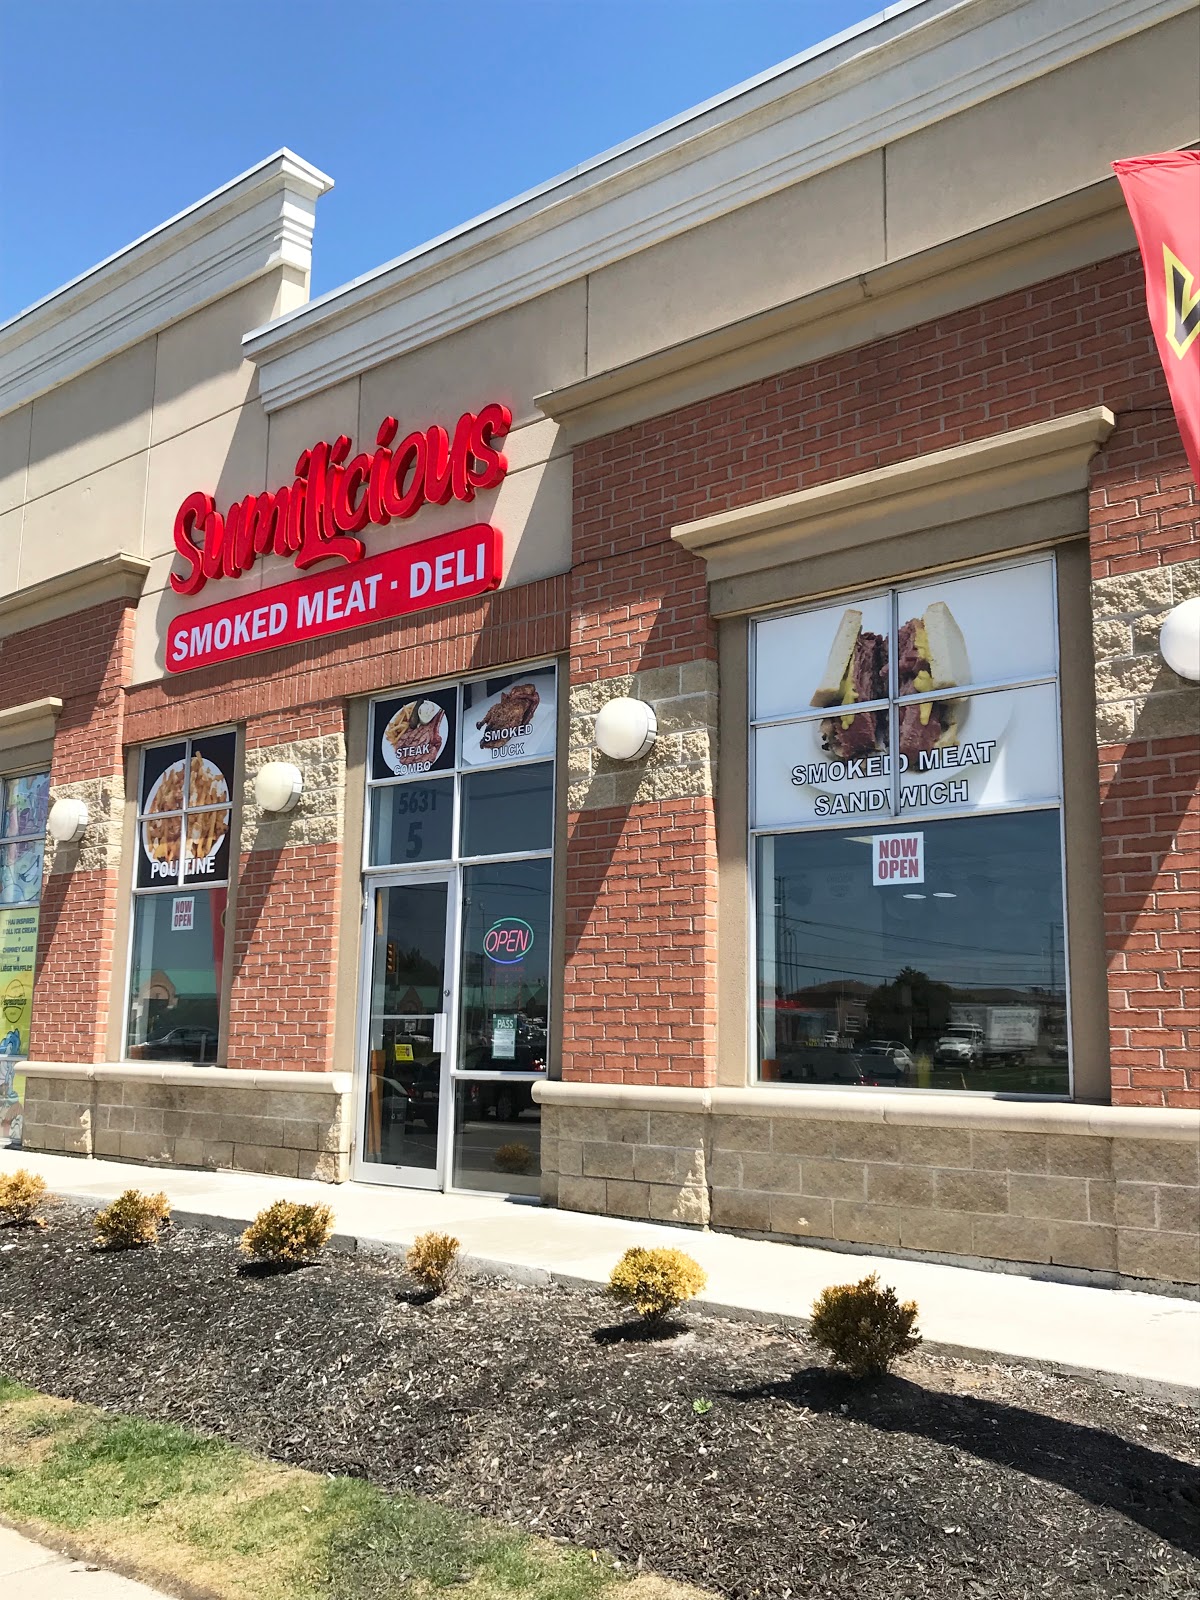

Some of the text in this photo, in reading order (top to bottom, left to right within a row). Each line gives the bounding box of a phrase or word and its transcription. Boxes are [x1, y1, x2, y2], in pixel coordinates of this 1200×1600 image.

[172, 602, 288, 662] SMOKED
[296, 573, 383, 629] MEAT
[409, 543, 486, 598] DELI
[484, 723, 533, 743] SMOKED
[396, 743, 430, 759] STEAK
[491, 743, 525, 759] DUCK
[393, 760, 431, 776] COMBO
[791, 740, 996, 786] SMOKED MEAT
[398, 789, 437, 815] 5631
[815, 780, 969, 816] SANDWICH
[406, 821, 423, 858] 5
[879, 837, 918, 859] NOW
[150, 856, 216, 879] POUTINE
[878, 858, 919, 880] OPEN
[175, 900, 193, 914] NOW
[174, 914, 192, 927] OPEN
[485, 929, 529, 952] OPEN
[497, 1019, 514, 1029] PASS
